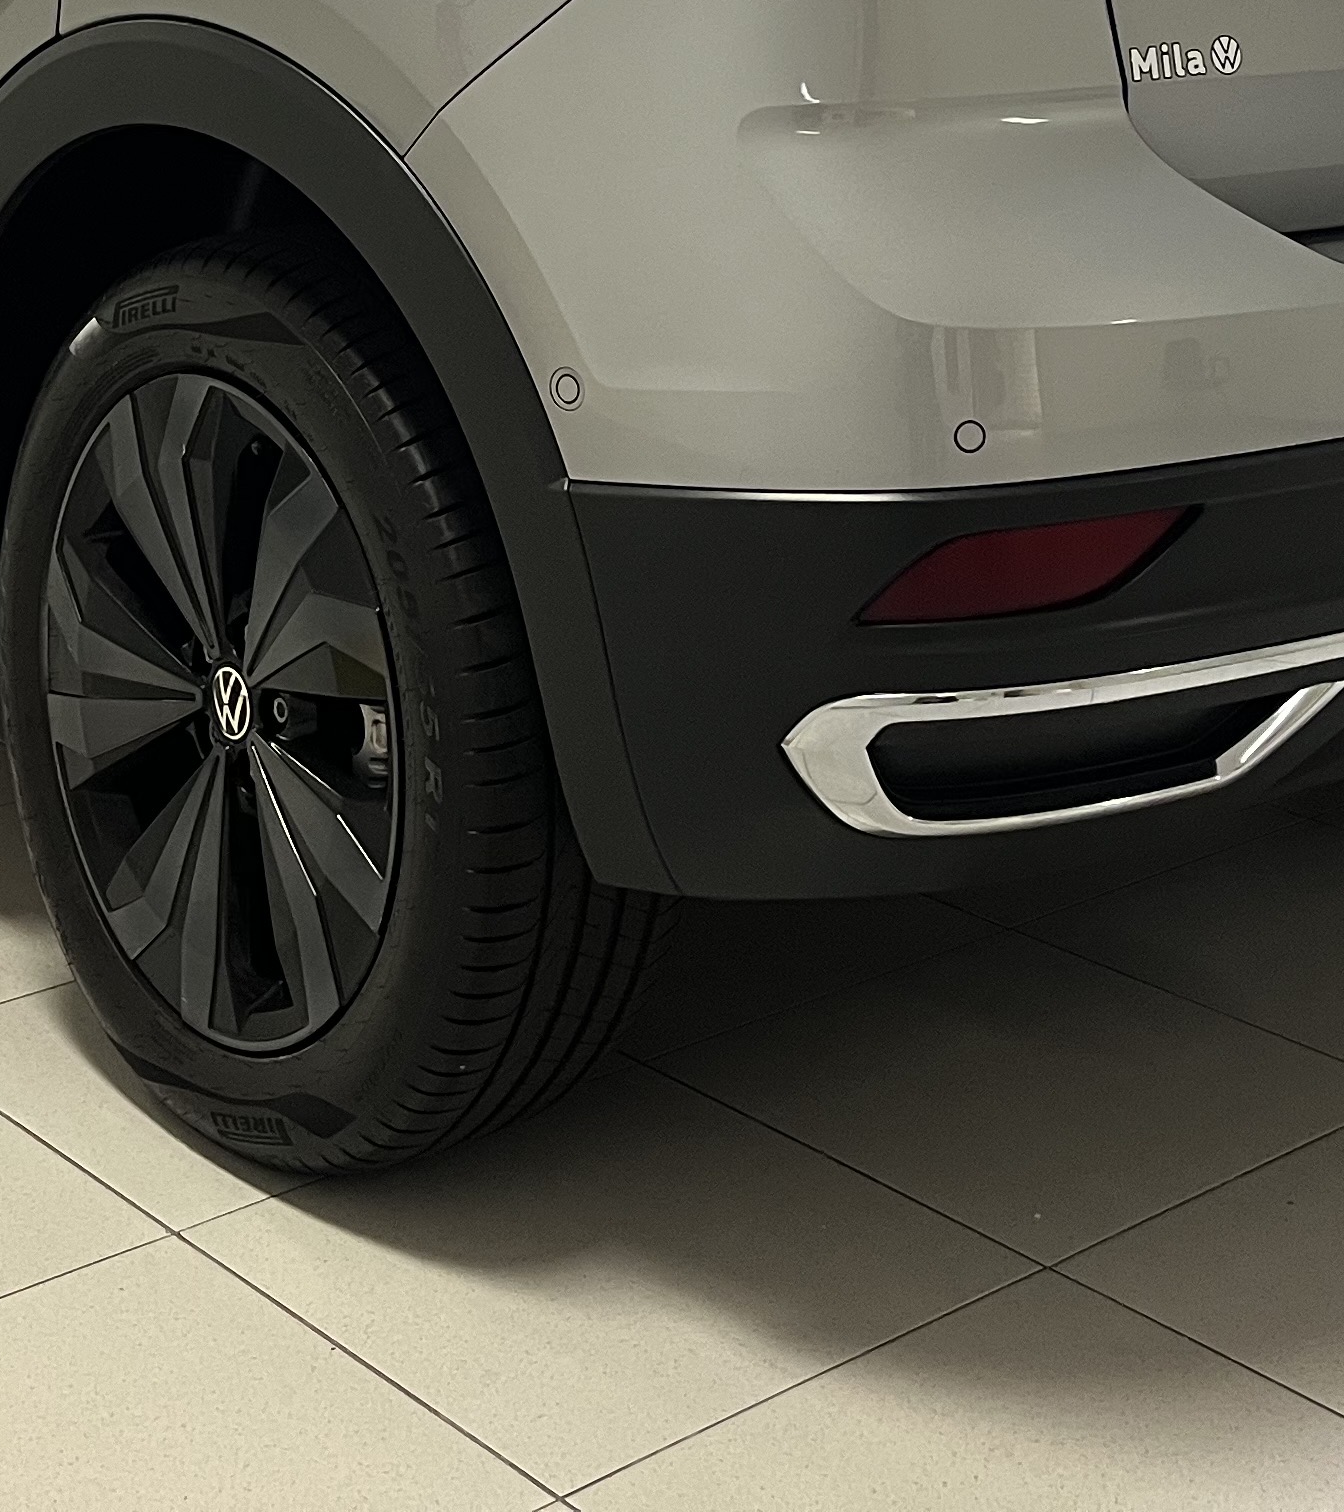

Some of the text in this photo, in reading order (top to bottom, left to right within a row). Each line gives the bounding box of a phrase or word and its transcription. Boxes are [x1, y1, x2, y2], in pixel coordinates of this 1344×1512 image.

[1129, 41, 1207, 82] Mila
[111, 284, 180, 329] PIRELLI
[211, 1111, 294, 1146] PIRELLI
